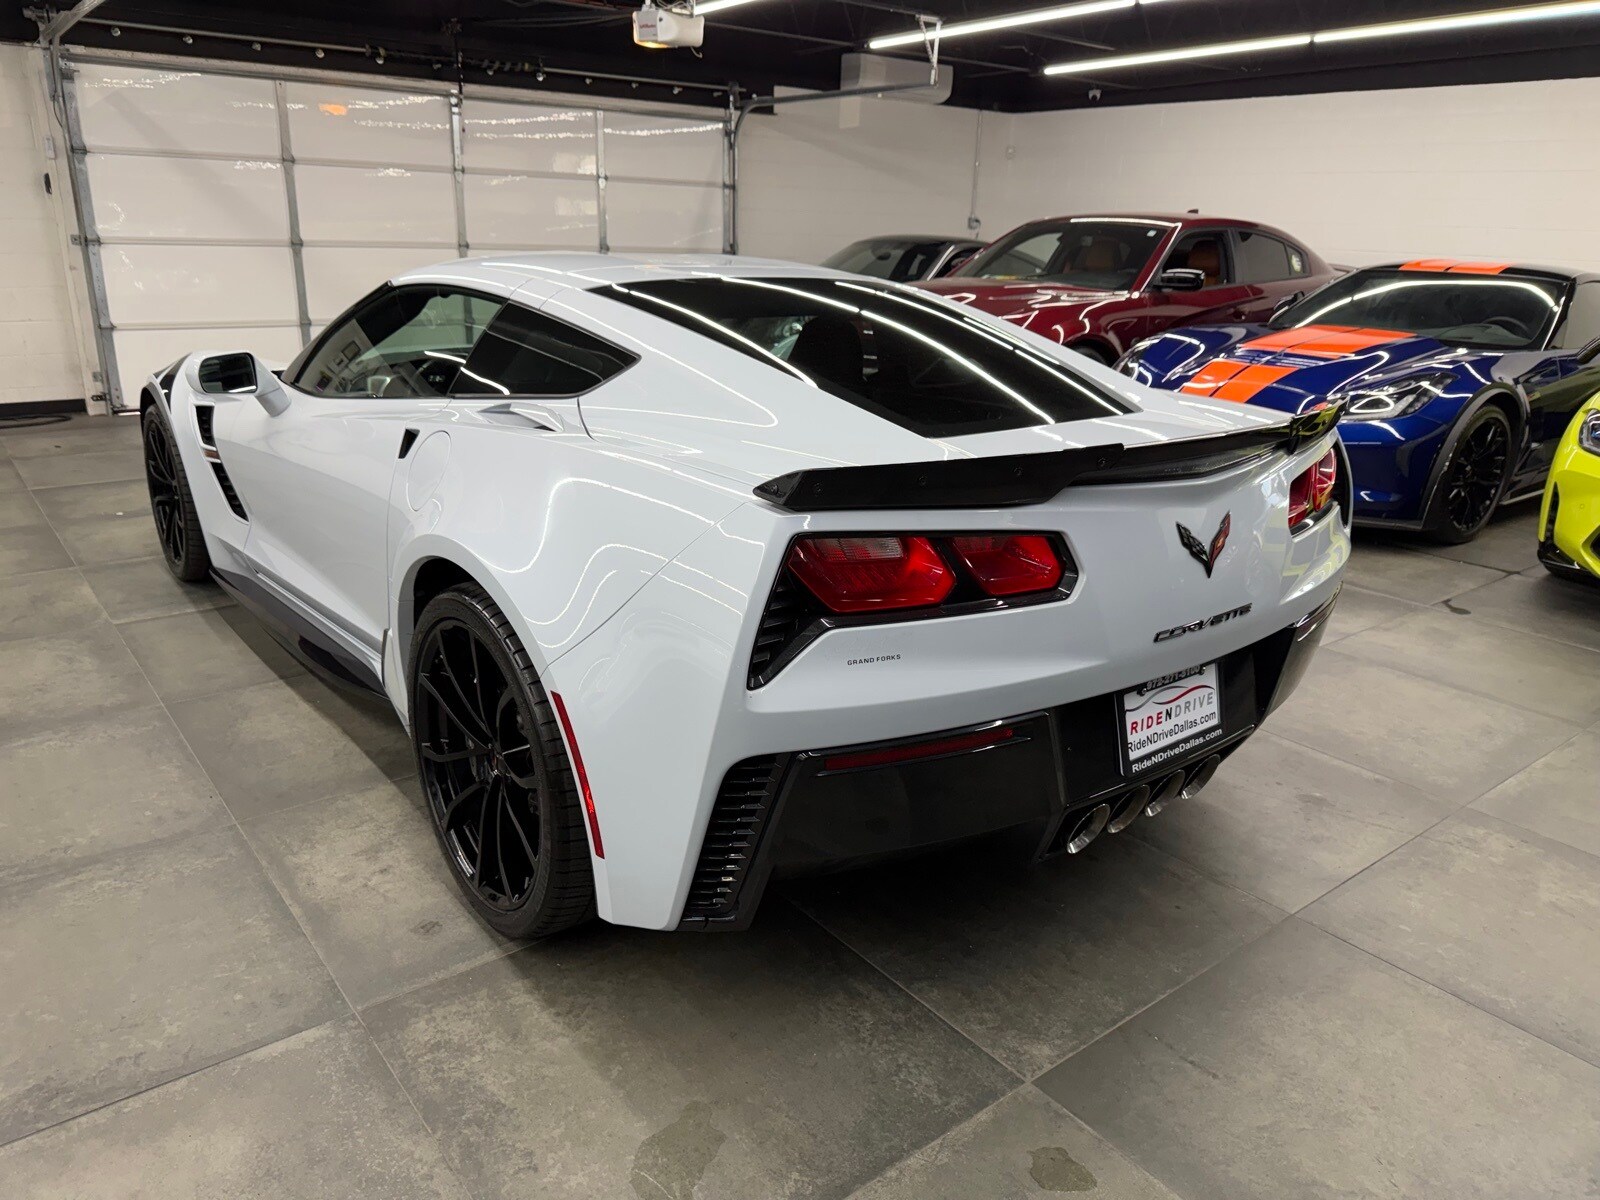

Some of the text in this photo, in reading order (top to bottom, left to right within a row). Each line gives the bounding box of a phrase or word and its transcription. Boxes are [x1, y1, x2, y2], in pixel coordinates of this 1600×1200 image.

[1153, 602, 1253, 643] CORVETTE
[847, 653, 902, 666] GRAND FORKS
[1127, 711, 1217, 753] RideNDriveDallas.com
[1130, 692, 1214, 735] RIDENDRIVE
[1132, 728, 1223, 773] RideNDriveDallas.com
